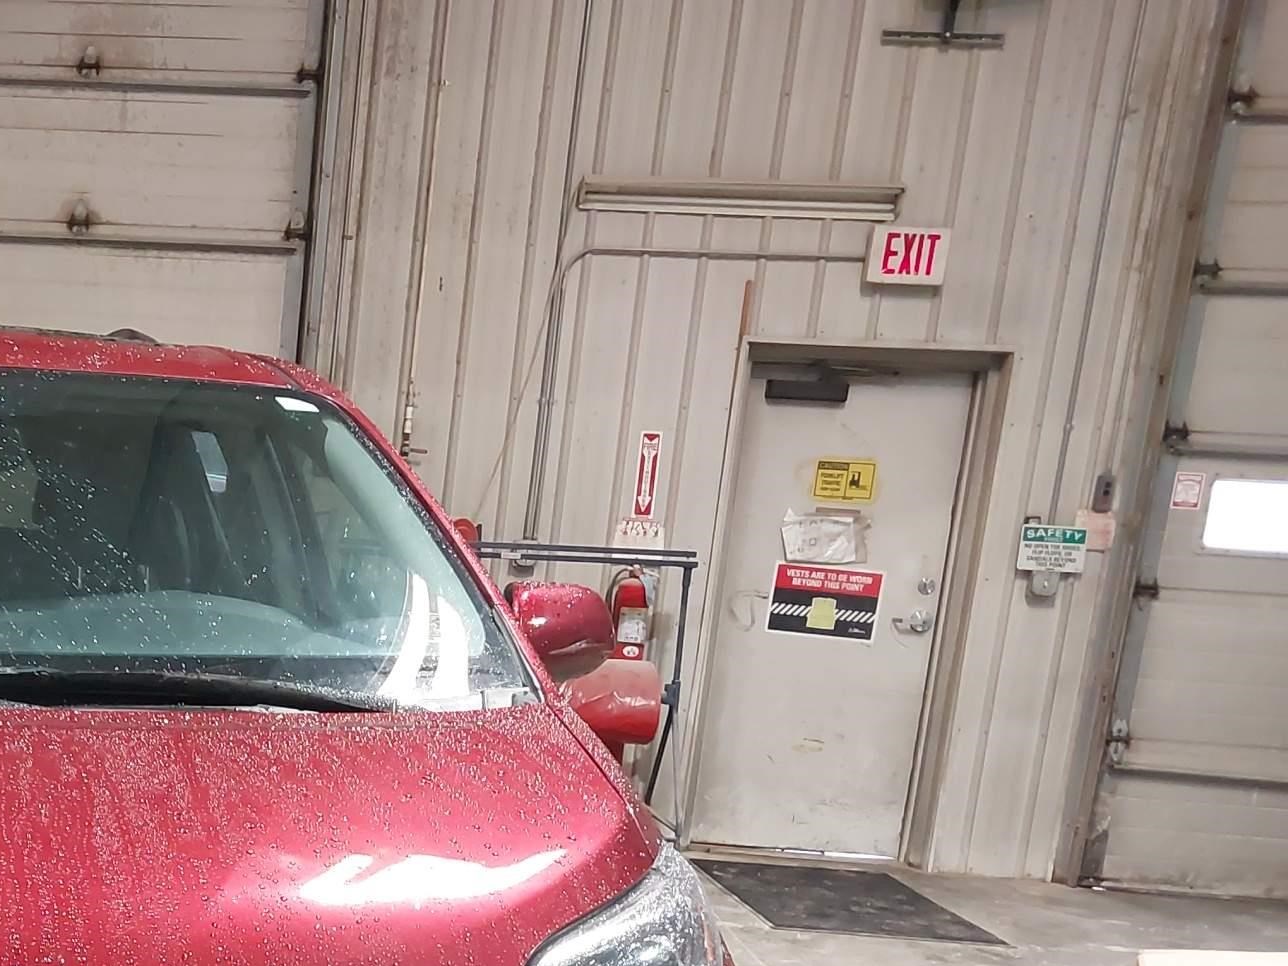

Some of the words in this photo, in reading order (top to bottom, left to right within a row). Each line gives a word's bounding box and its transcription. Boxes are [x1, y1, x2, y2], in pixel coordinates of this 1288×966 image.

[881, 232, 941, 275] EXIT
[1026, 528, 1083, 541] SAFETY
[787, 568, 810, 578] VESTS
[811, 570, 825, 580] ARE
[827, 571, 836, 581] TO
[838, 573, 848, 582] BE
[849, 574, 873, 584] WORN
[792, 577, 822, 588] BEYOND
[824, 580, 840, 590] THIS
[841, 582, 865, 592] POINT
